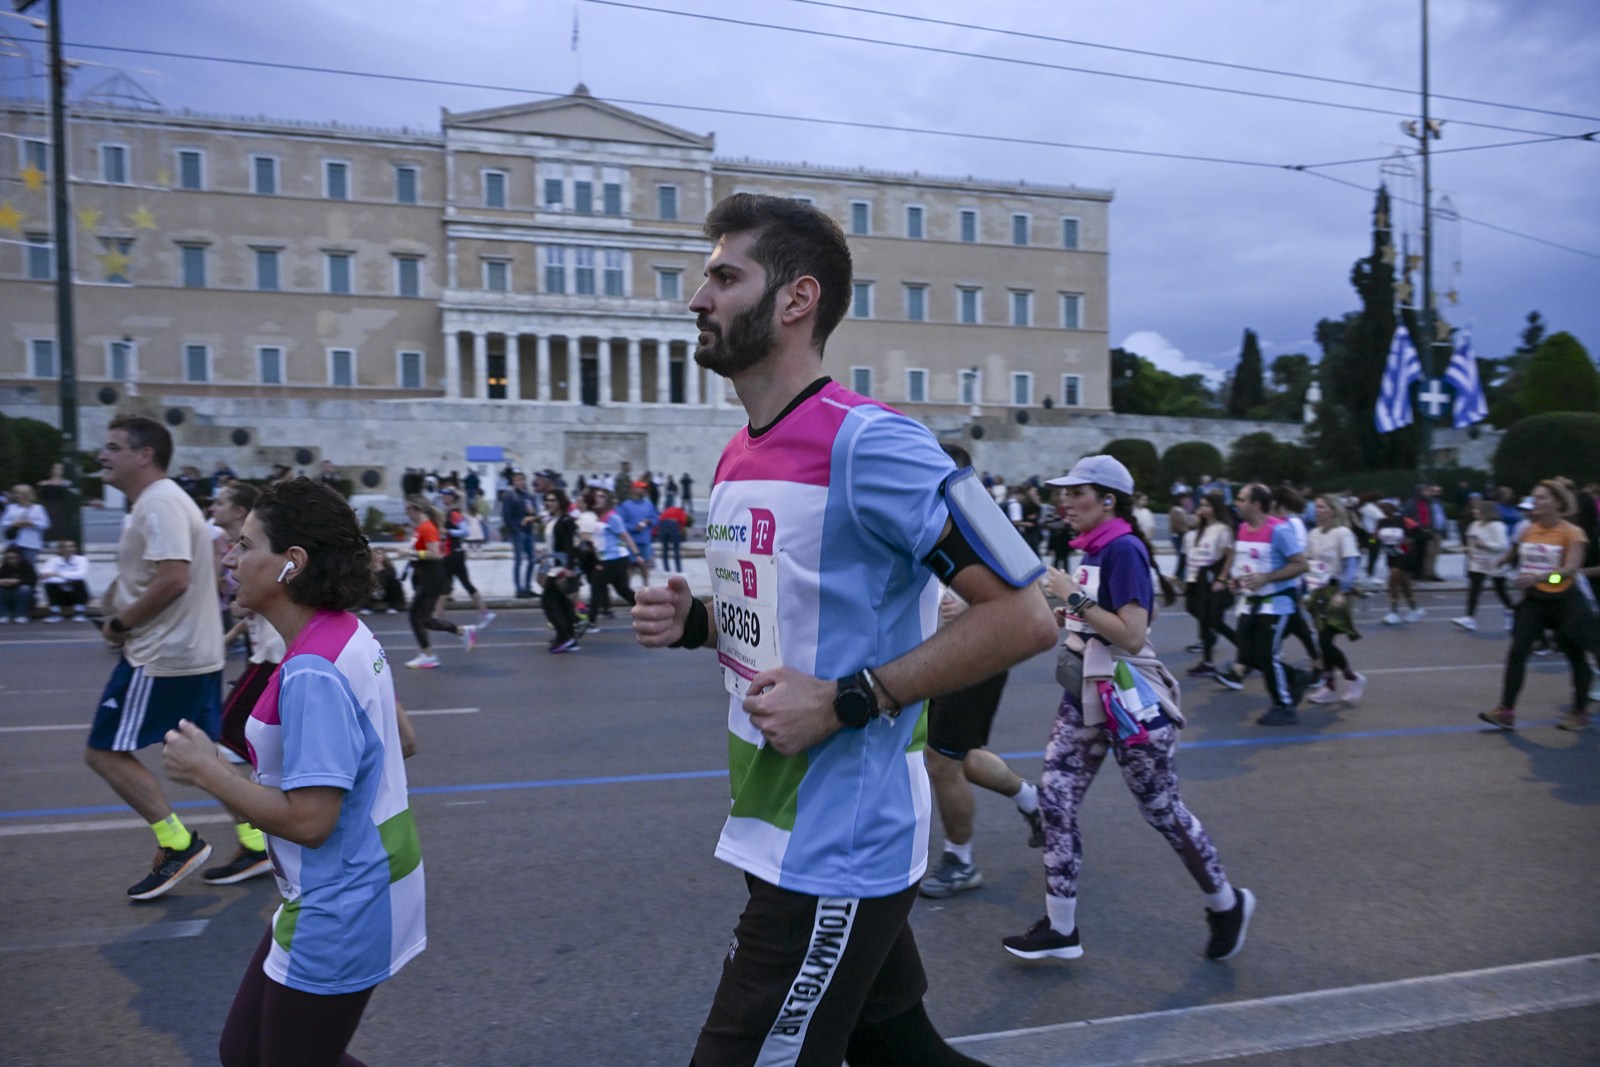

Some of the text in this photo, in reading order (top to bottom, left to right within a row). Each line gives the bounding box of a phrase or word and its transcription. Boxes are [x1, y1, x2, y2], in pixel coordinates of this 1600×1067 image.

[715, 567, 741, 584] COSMOTE
[721, 601, 760, 648] 58369
[771, 902, 852, 1037] TOMMYGLAIR
